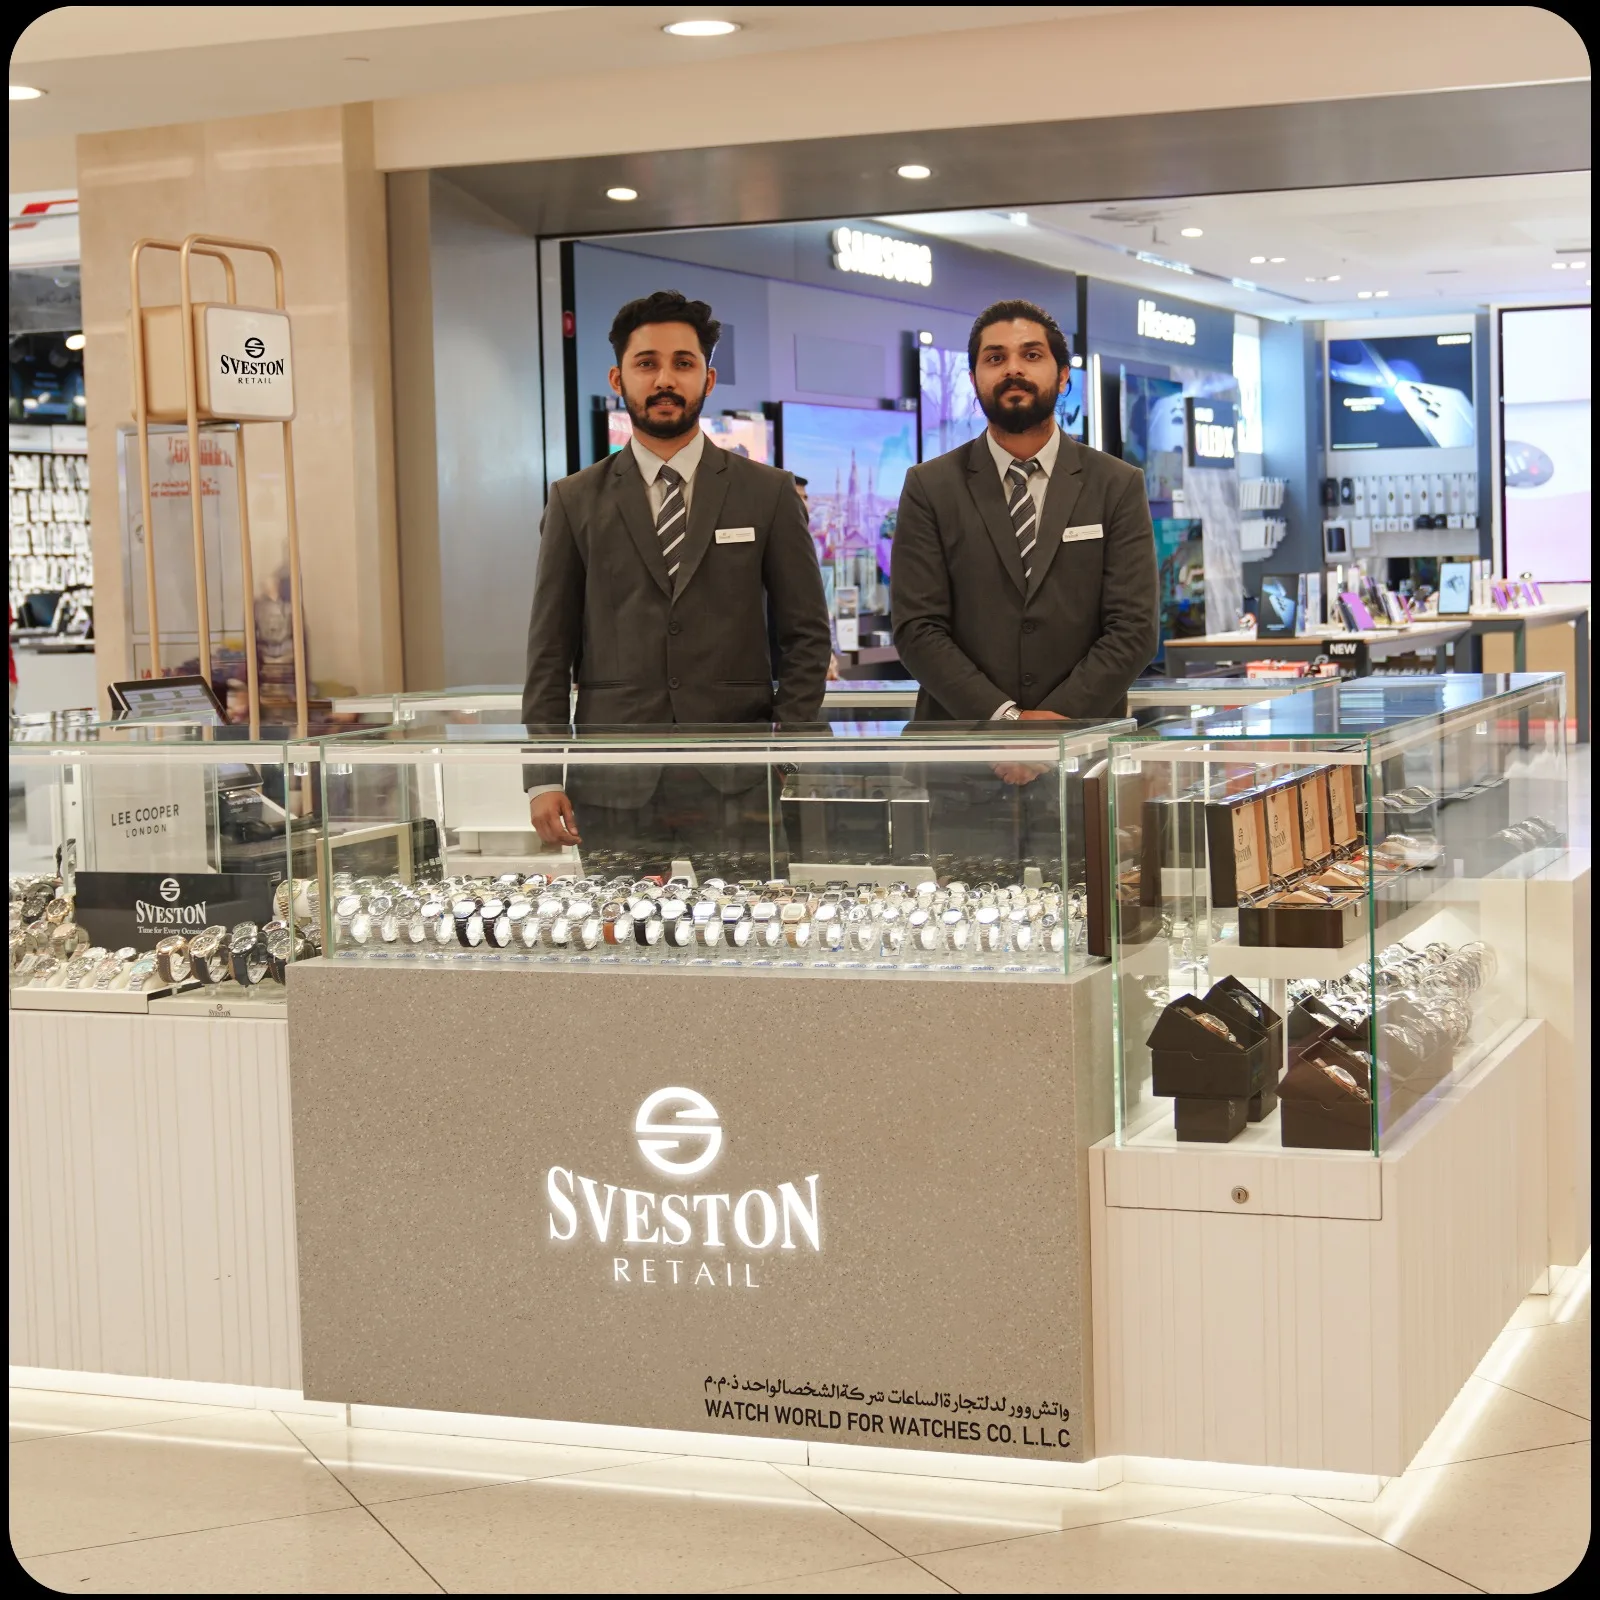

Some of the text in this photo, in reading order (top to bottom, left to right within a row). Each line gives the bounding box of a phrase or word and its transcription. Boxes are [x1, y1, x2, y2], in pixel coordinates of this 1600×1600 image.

[220, 354, 284, 375] SVESTON
[1329, 643, 1357, 655] NEW
[111, 804, 180, 827] LEE COOPER
[125, 824, 167, 838] LONDON
[135, 900, 207, 925] SVESTON
[137, 926, 205, 936] Time for Every Occasio
[547, 1166, 819, 1251] SVESTON
[613, 1258, 760, 1288] RETAIL
[704, 1398, 1071, 1448] WATCH WORLD FOR WATCHES CO. L.L.C
